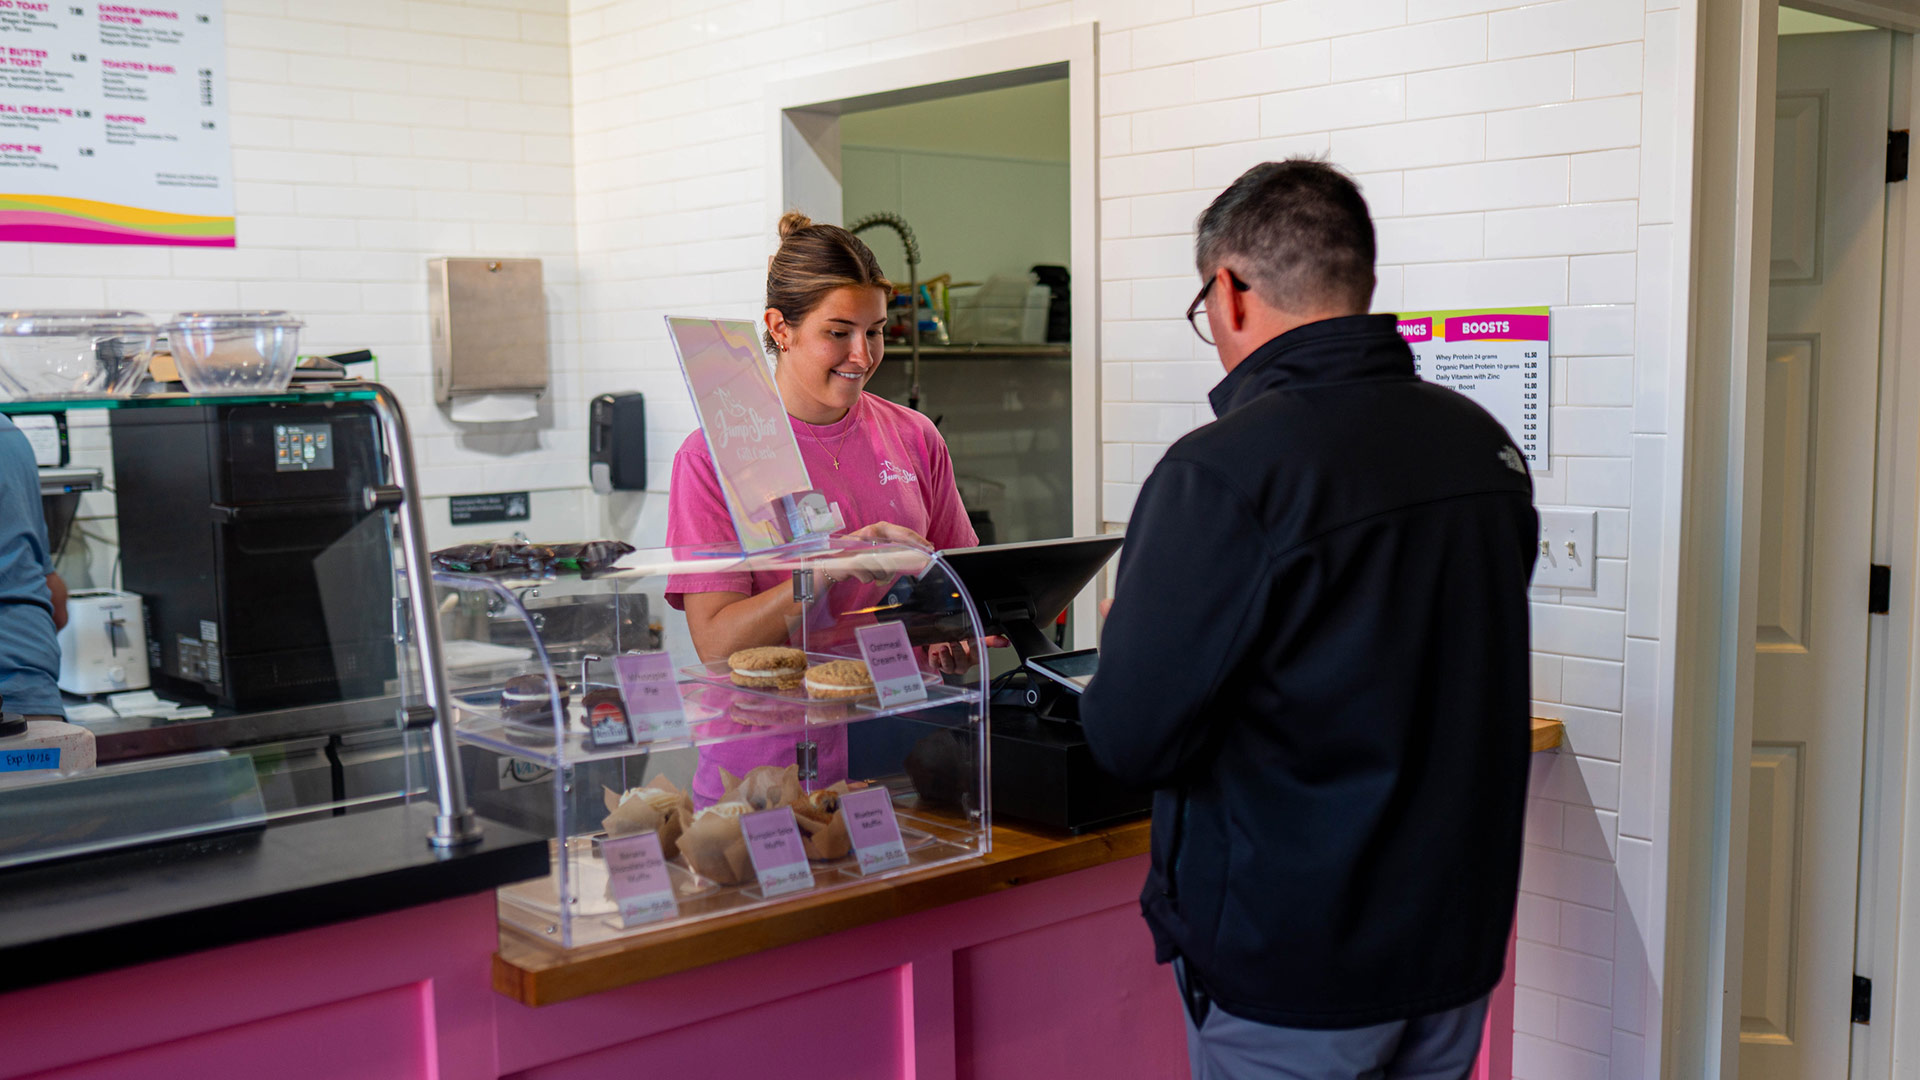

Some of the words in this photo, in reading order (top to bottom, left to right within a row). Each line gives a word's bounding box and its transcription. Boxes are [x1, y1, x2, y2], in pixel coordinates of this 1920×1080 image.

[16, 1, 49, 12] TOAST
[9, 47, 48, 58] BUTTER
[9, 57, 42, 67] TOAST
[21, 105, 56, 115] CREAM
[1396, 324, 1427, 336] PINGS
[1462, 321, 1510, 334] BOOSTS
[870, 639, 902, 653] Oatmeal
[872, 655, 895, 666] Cream
[896, 653, 908, 662] Pie
